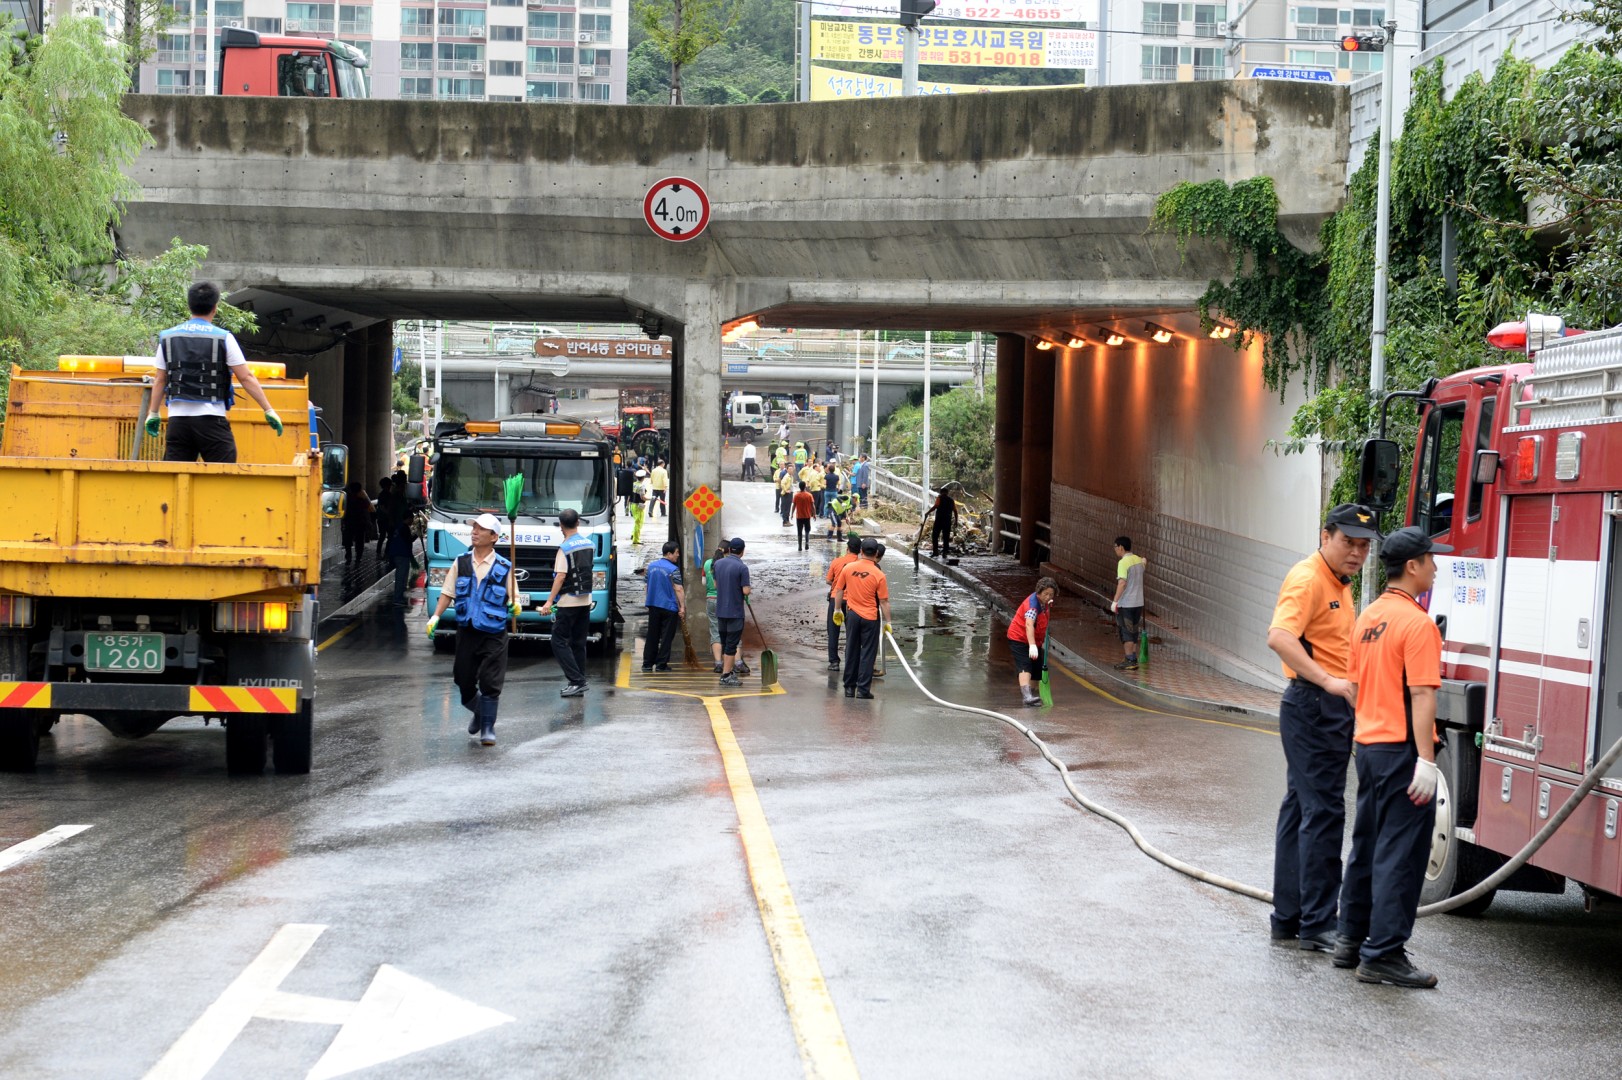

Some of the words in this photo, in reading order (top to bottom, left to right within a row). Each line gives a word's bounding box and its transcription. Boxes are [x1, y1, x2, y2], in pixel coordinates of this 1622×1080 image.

[858, 48, 882, 59] 간병사
[948, 50, 1041, 66] 531-9018
[654, 197, 698, 222] 4.0m
[566, 341, 610, 355] 반여4동
[614, 343, 663, 356] 삼어마을
[515, 534, 551, 544] 해운대구
[103, 635, 144, 647] 85가
[95, 648, 158, 669] 1260
[238, 678, 302, 688] HYUNDAI
